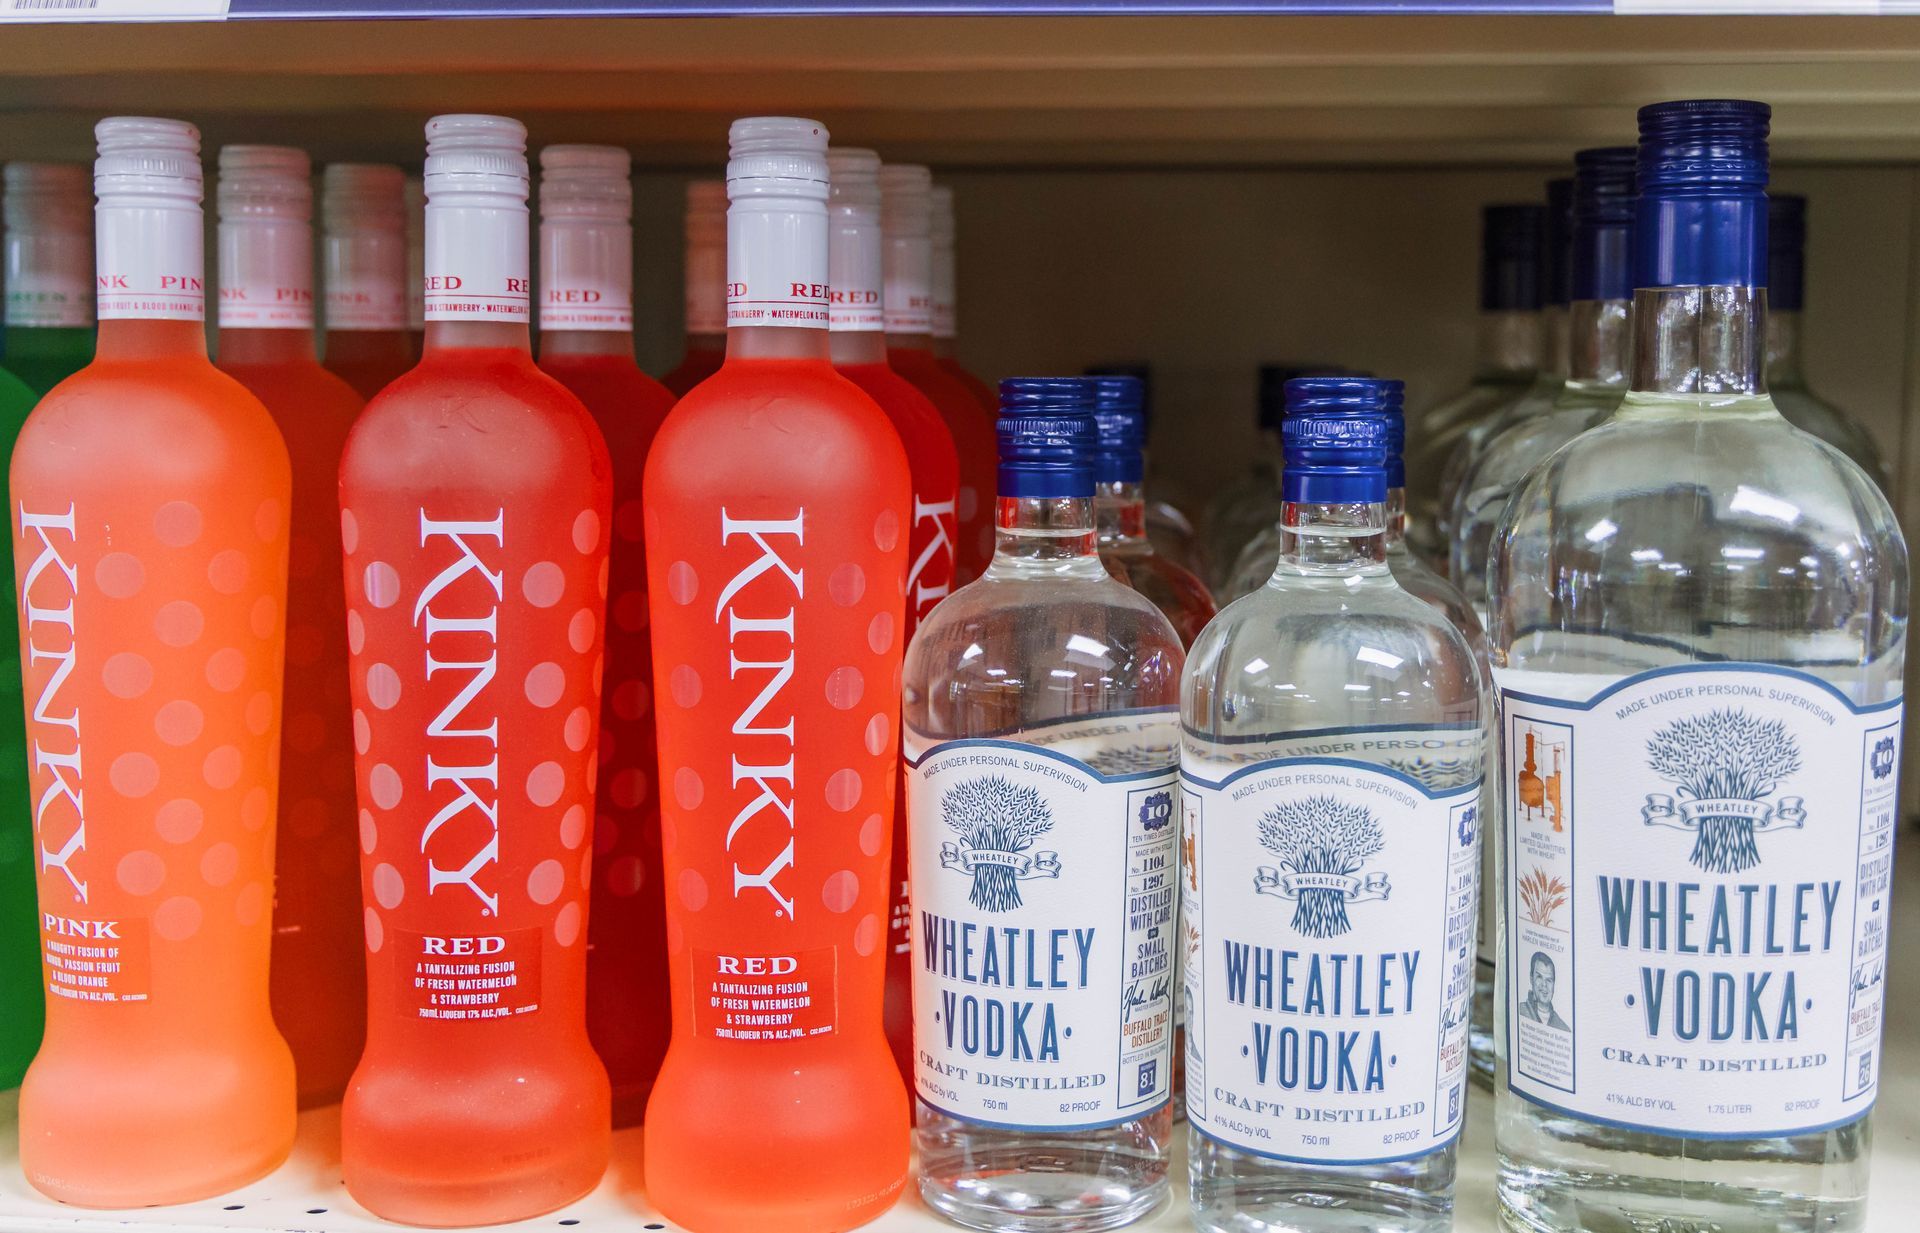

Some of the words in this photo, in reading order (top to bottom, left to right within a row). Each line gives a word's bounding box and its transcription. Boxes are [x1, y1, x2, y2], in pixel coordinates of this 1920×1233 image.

[550, 290, 601, 303] RED
[790, 283, 829, 299] RED
[830, 291, 878, 304] RED
[772, 310, 814, 320] WATERMELON
[20, 500, 88, 905] KINKY
[1615, 702, 1649, 721] MADE
[1650, 685, 1694, 705] UNDER
[1698, 684, 1764, 698] PERSONAL
[1768, 689, 1837, 726] SUPERVISION
[414, 507, 503, 918] KINKY
[715, 507, 804, 920] KINKY
[923, 763, 941, 780] MADE
[940, 756, 968, 771] UNDER
[970, 755, 1020, 769] PERSONAL
[1022, 761, 1089, 793] SUPERVISION
[1232, 784, 1256, 803] MADE
[1257, 776, 1292, 791] UNDER
[1295, 774, 1353, 787] PERSONAL
[1355, 778, 1418, 810] SUPERVISION
[1147, 803, 1169, 821] 10
[1695, 803, 1759, 815] WHEATLEY
[1132, 835, 1142, 843] TEN
[971, 853, 1018, 865] WHEATLEY
[1144, 855, 1165, 872] 1104
[1142, 874, 1164, 891] 1297
[1295, 877, 1349, 888] WHEATLEY
[1131, 887, 1172, 913] DISTILLED
[1131, 912, 1153, 930] WITH
[1597, 875, 1841, 957] WHEATLEY
[44, 912, 121, 939] PINK
[78, 946, 105, 957] FUSION
[108, 948, 119, 958] OF
[422, 936, 505, 955] RED
[921, 910, 1096, 990] WHEATLEY
[1138, 937, 1165, 960] SMALL
[65, 959, 94, 972] PASSION
[97, 963, 120, 973] FRUIT
[417, 963, 422, 973] A
[425, 963, 480, 975] TANTALIZING
[483, 961, 515, 974] FUSION
[717, 956, 798, 975] RED
[1131, 952, 1169, 978] BATCHES
[78, 976, 108, 987] ORANGE
[415, 978, 425, 988] OF
[428, 978, 455, 989] FRESH
[458, 974, 517, 990] WATERMELON
[1224, 939, 1421, 1018] WHEATLEY
[712, 982, 717, 992] A
[720, 983, 773, 995] TANTALIZING
[776, 982, 808, 994] FUSION
[431, 994, 437, 1004] &
[440, 993, 500, 1005] STRAWBERRY
[711, 997, 721, 1007] OF
[723, 998, 749, 1010] FRESH
[752, 997, 810, 1010] WATERMELON
[1640, 966, 1799, 1044] VODKA
[440, 1010, 466, 1019] LIQUEUR
[468, 1009, 479, 1018] 17%
[727, 1014, 732, 1024] &
[735, 1014, 793, 1025] STRAWBERRY
[735, 1030, 760, 1039] LIQUEUR
[762, 1030, 774, 1039] 17%
[776, 1028, 806, 1039] ALC./VOL.
[943, 989, 1060, 1062] VODKA
[1124, 1017, 1152, 1037] BUFFALO
[1132, 1027, 1163, 1048] DISTILLERY
[1252, 1022, 1385, 1094] VODKA
[1602, 1047, 1688, 1070] CRAFT
[1699, 1053, 1827, 1072] DISTILLED
[919, 1050, 968, 1081] CRAFT
[976, 1073, 1106, 1090] DISTILLED
[1140, 1070, 1155, 1088] 81
[939, 1087, 945, 1098] by
[947, 1090, 959, 1102] VOL
[1606, 1093, 1624, 1106] 41%
[1626, 1096, 1644, 1106] ALC
[1645, 1098, 1657, 1108] BY
[1657, 1100, 1677, 1111] VOL
[983, 1099, 997, 1110] 750
[1059, 1103, 1070, 1113] 82
[1072, 1101, 1101, 1112] PROOF
[1214, 1087, 1284, 1117] CRAFT
[1295, 1101, 1425, 1123] DISTILLED
[1708, 1105, 1725, 1114] 1.75
[1727, 1104, 1752, 1114] LITER
[1784, 1102, 1795, 1111] 82
[1796, 1099, 1821, 1111] PROOF
[1214, 1114, 1228, 1127] 41%
[1228, 1120, 1243, 1133] ALC
[1244, 1125, 1254, 1137] by
[1255, 1128, 1272, 1140] VOL
[1302, 1135, 1317, 1145] 750
[1383, 1135, 1393, 1145] 82
[1394, 1129, 1420, 1143] PROOF
